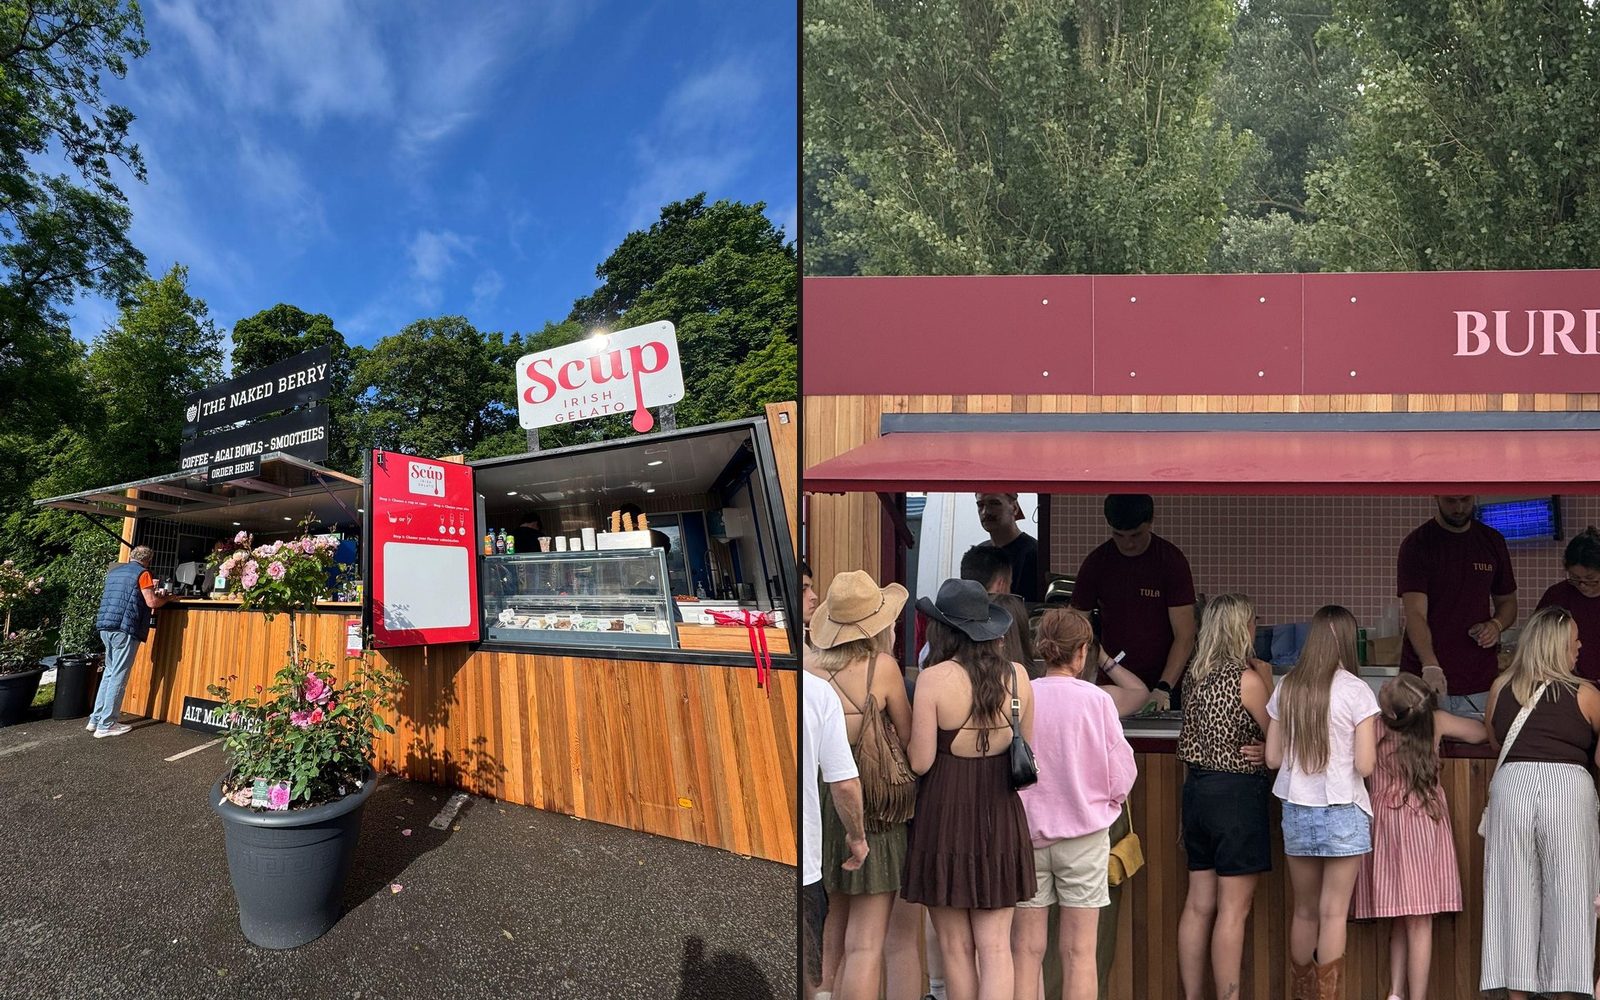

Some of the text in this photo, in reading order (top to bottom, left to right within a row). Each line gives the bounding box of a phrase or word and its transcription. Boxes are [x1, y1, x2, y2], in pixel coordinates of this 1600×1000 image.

[203, 363, 328, 417] THE NAKED BERRY
[563, 390, 612, 408] IRISH
[555, 402, 625, 423] GELATO
[181, 452, 209, 470] COFFEE
[214, 449, 233, 463] ACAI
[234, 441, 263, 459] BOWLS
[270, 426, 325, 451] SMOOTHIES
[211, 461, 255, 479] ORDER HERE
[411, 464, 443, 495] Scúp
[1472, 562, 1493, 572] TULA
[1140, 588, 1160, 598] TULA
[184, 705, 202, 723] ALT
[203, 708, 230, 729] MILK
